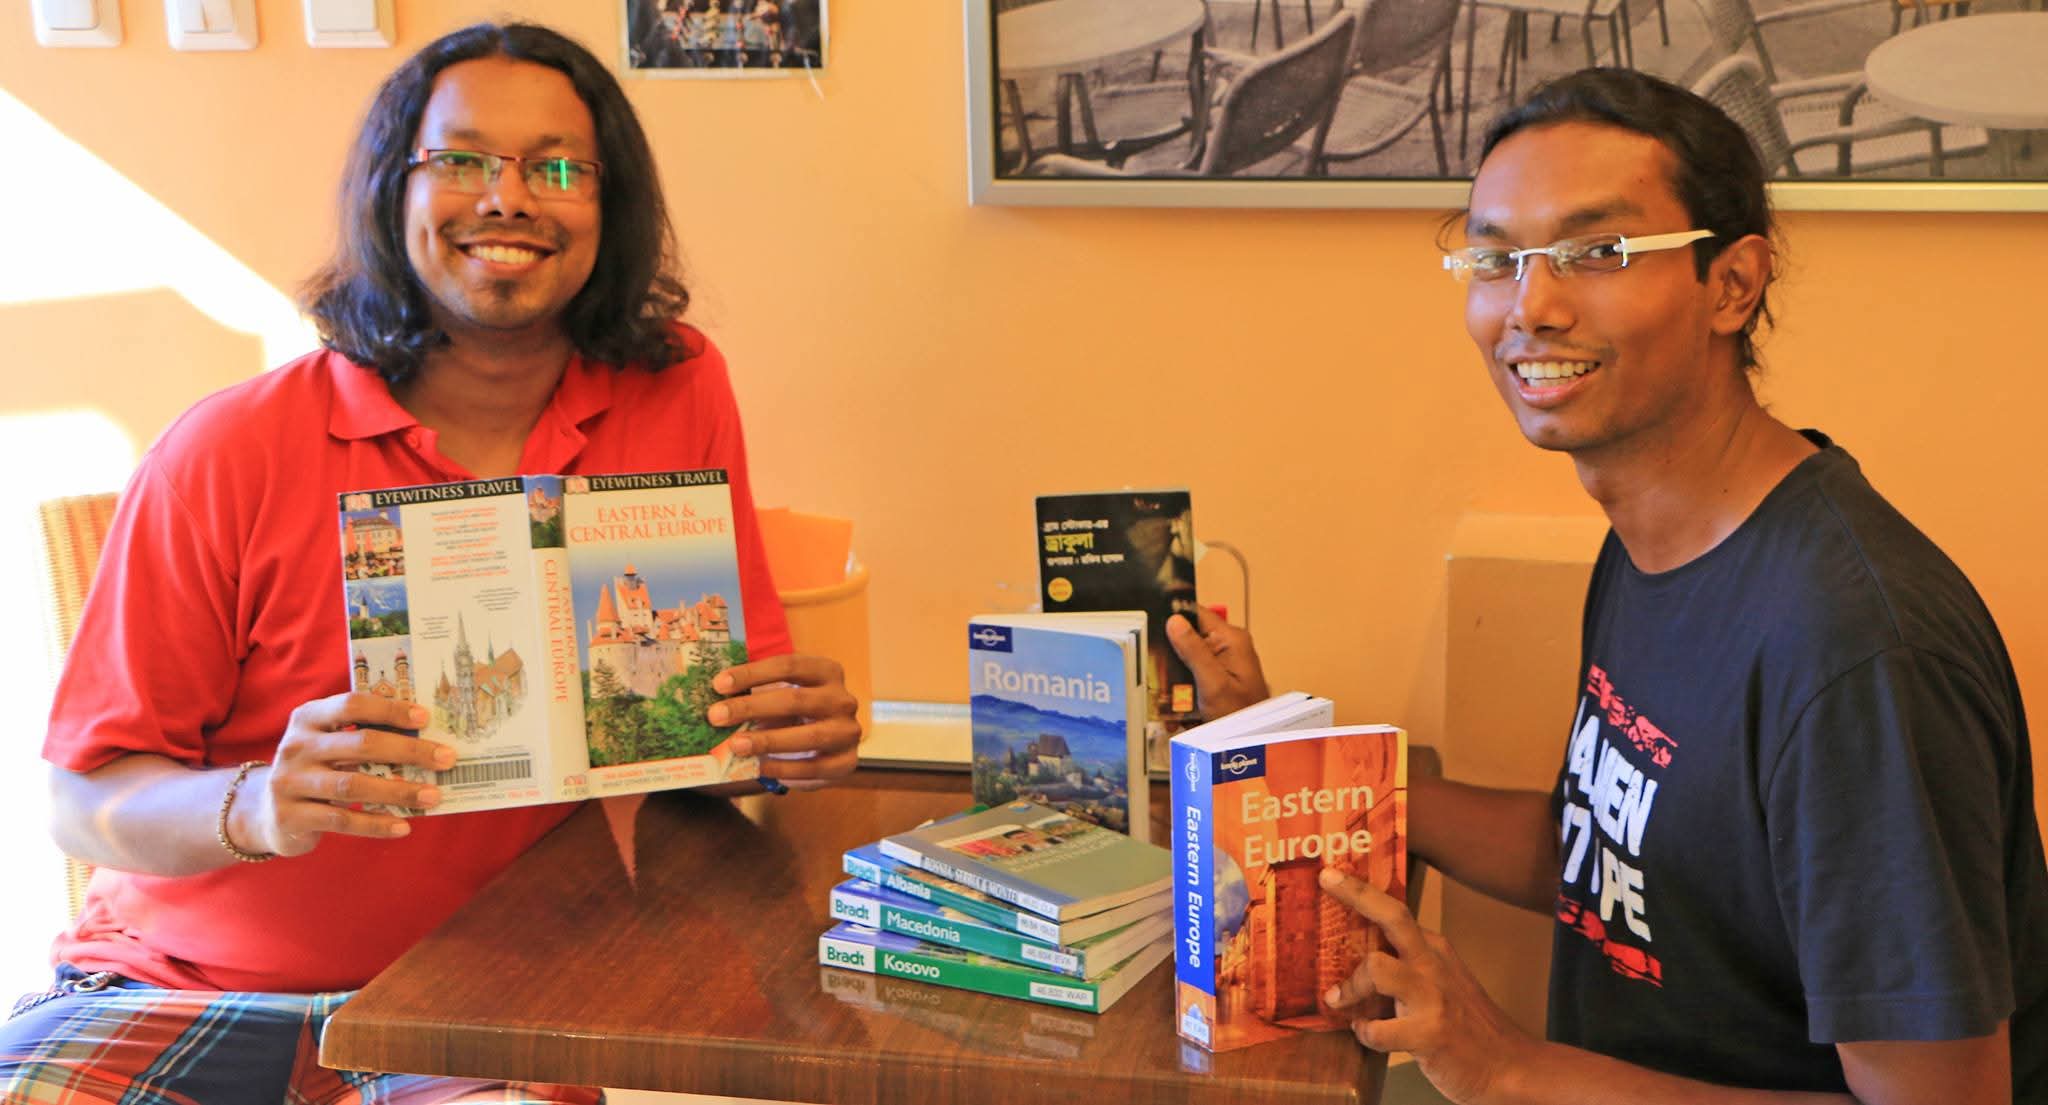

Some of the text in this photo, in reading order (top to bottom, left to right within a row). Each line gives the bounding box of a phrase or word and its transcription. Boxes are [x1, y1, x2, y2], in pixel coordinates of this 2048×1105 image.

[376, 483, 464, 505] EYEWITNESS
[469, 478, 521, 497] TRAVEL
[592, 474, 672, 490] EYEWITNESS
[677, 470, 724, 485] TRAVEL
[597, 501, 696, 523] EASTERN &
[570, 518, 728, 543] CENTRAL EUROPE
[544, 559, 569, 703] CENTRAL EUROPE
[983, 662, 1111, 704] Romania
[1241, 785, 1375, 825] Eastern
[1243, 829, 1373, 869] Europe
[886, 874, 931, 899] Albania
[1186, 806, 1203, 968] Eastern Europe
[835, 899, 960, 942] Bradt Macedonia
[827, 946, 941, 978] Bradt Kosovo
